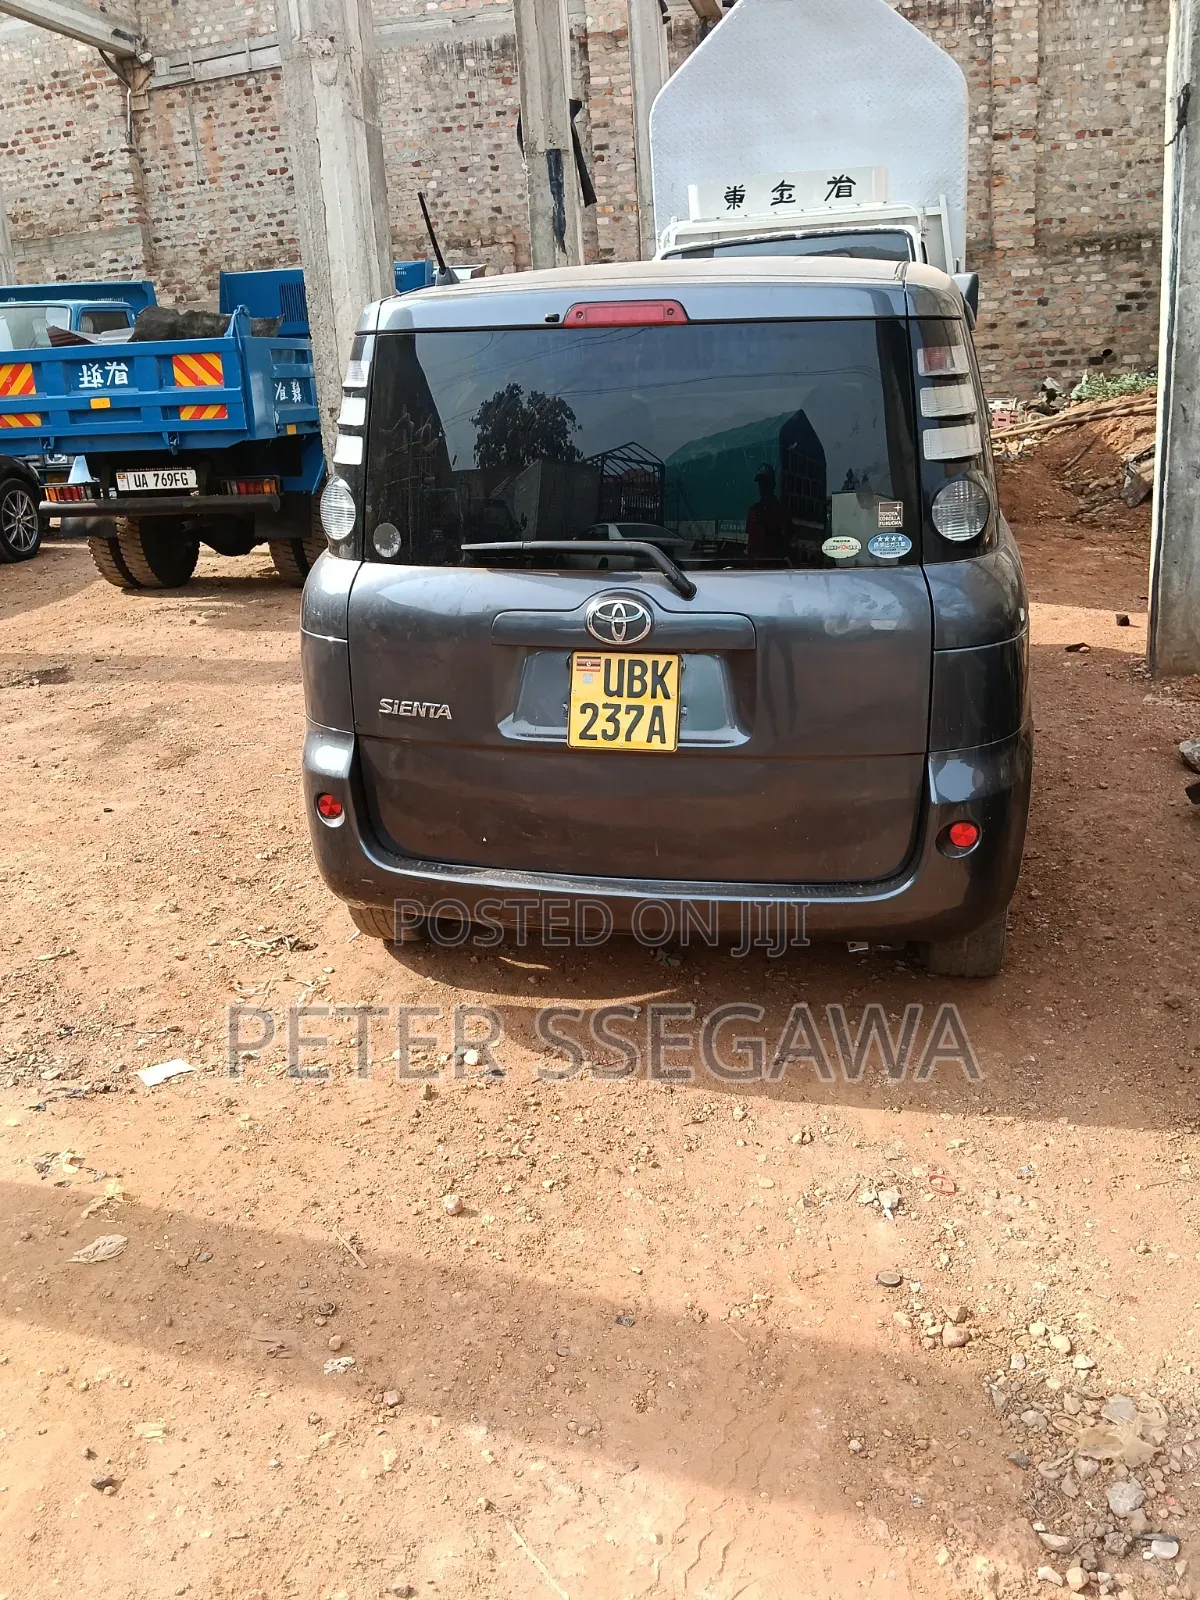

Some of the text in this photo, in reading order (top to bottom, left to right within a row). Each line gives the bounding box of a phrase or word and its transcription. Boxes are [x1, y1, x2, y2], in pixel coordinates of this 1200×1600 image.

[133, 472, 189, 488] UA 769FG
[603, 658, 673, 699] UBK
[579, 702, 667, 744] 237A
